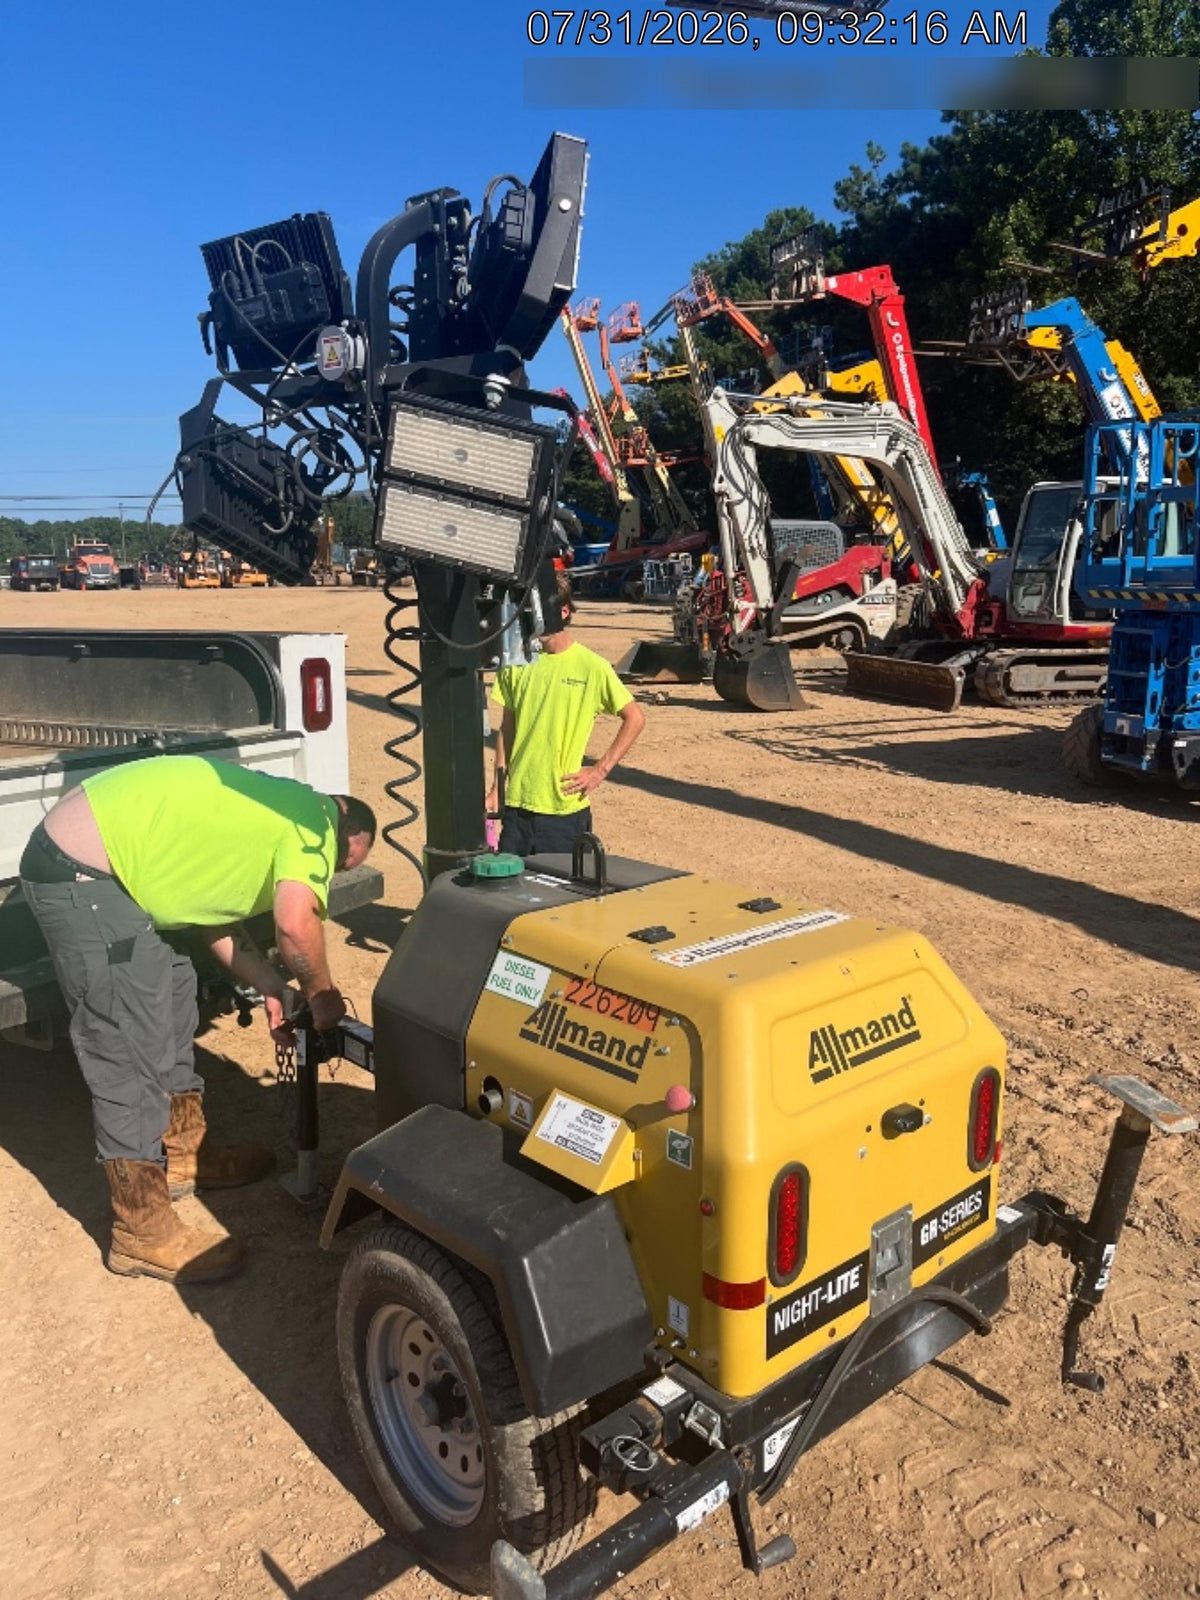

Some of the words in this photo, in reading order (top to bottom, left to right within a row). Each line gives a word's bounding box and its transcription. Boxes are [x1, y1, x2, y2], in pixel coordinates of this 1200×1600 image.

[489, 973, 513, 991] FUEL
[514, 982, 541, 1001] ONLY
[504, 959, 536, 980] DIESEL
[563, 977, 661, 1032] 226209
[523, 999, 652, 1070] Allmand
[808, 994, 917, 1075] Allmand
[920, 1190, 983, 1246] GR-SERIES
[773, 1265, 861, 1336] NIGHT-LITE
